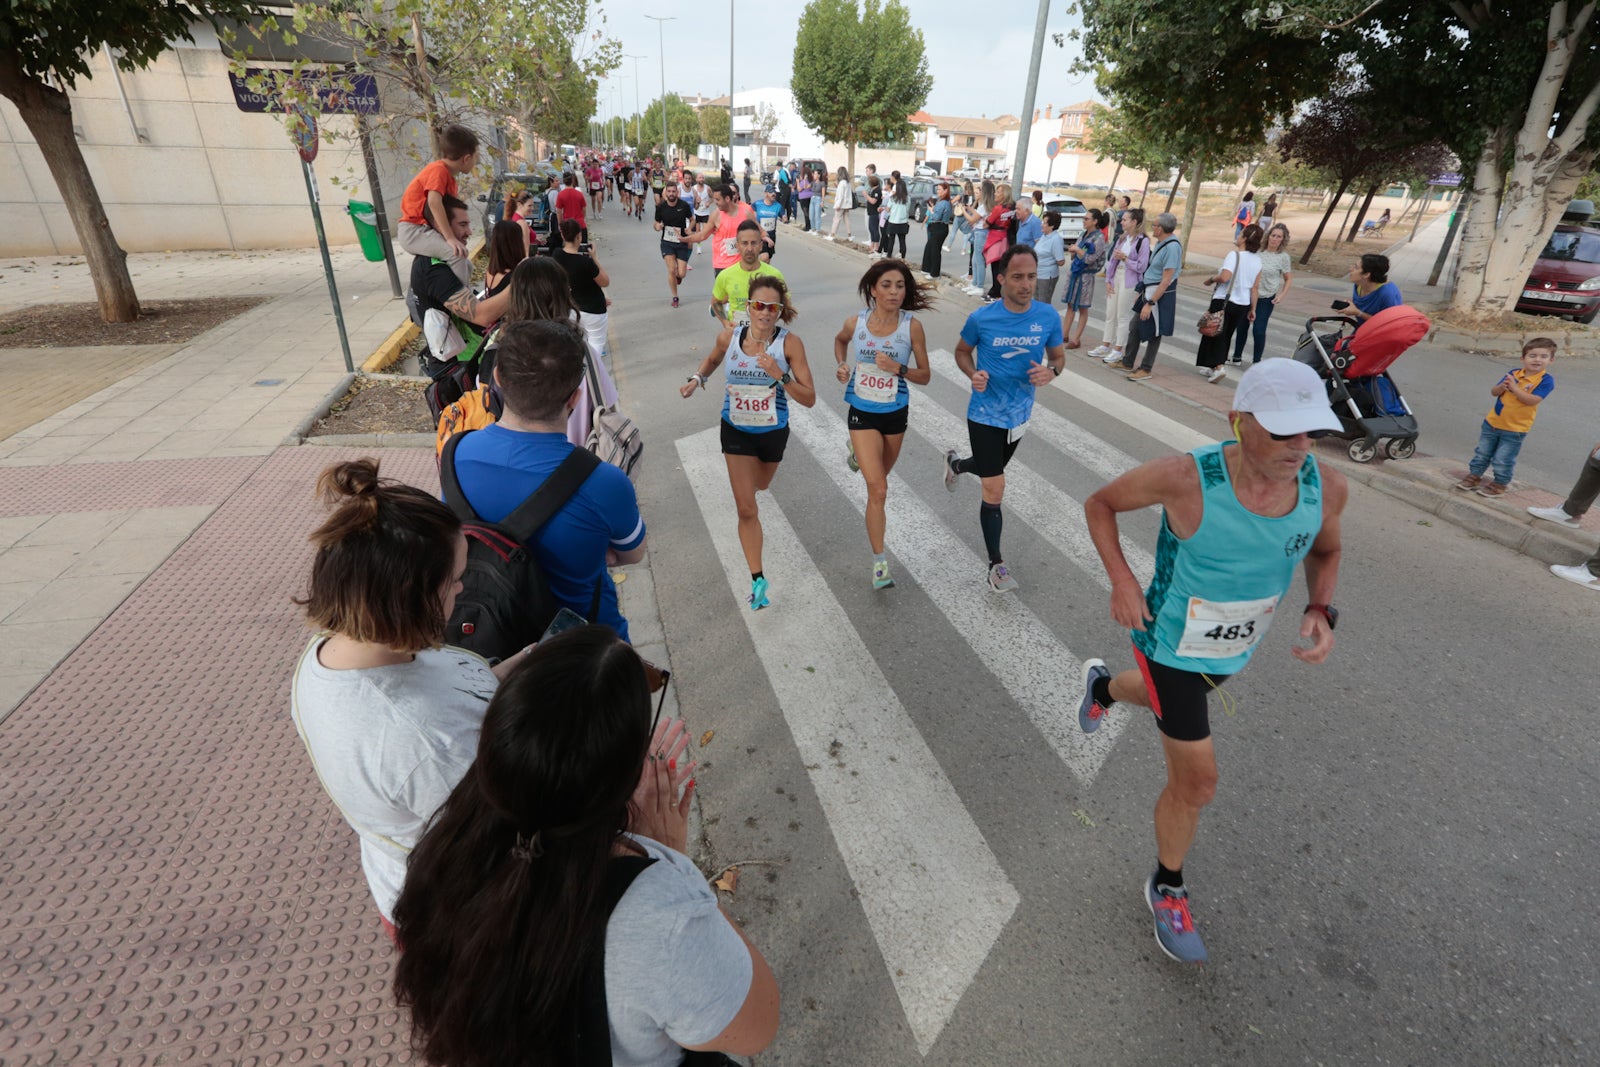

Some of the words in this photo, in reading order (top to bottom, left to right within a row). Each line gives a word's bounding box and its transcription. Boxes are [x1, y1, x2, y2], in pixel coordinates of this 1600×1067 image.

[992, 336, 1041, 346] BROOKS
[730, 369, 770, 378] MARACEN
[859, 373, 894, 390] 2064
[735, 397, 769, 412] 2188
[1204, 620, 1256, 640] 483
